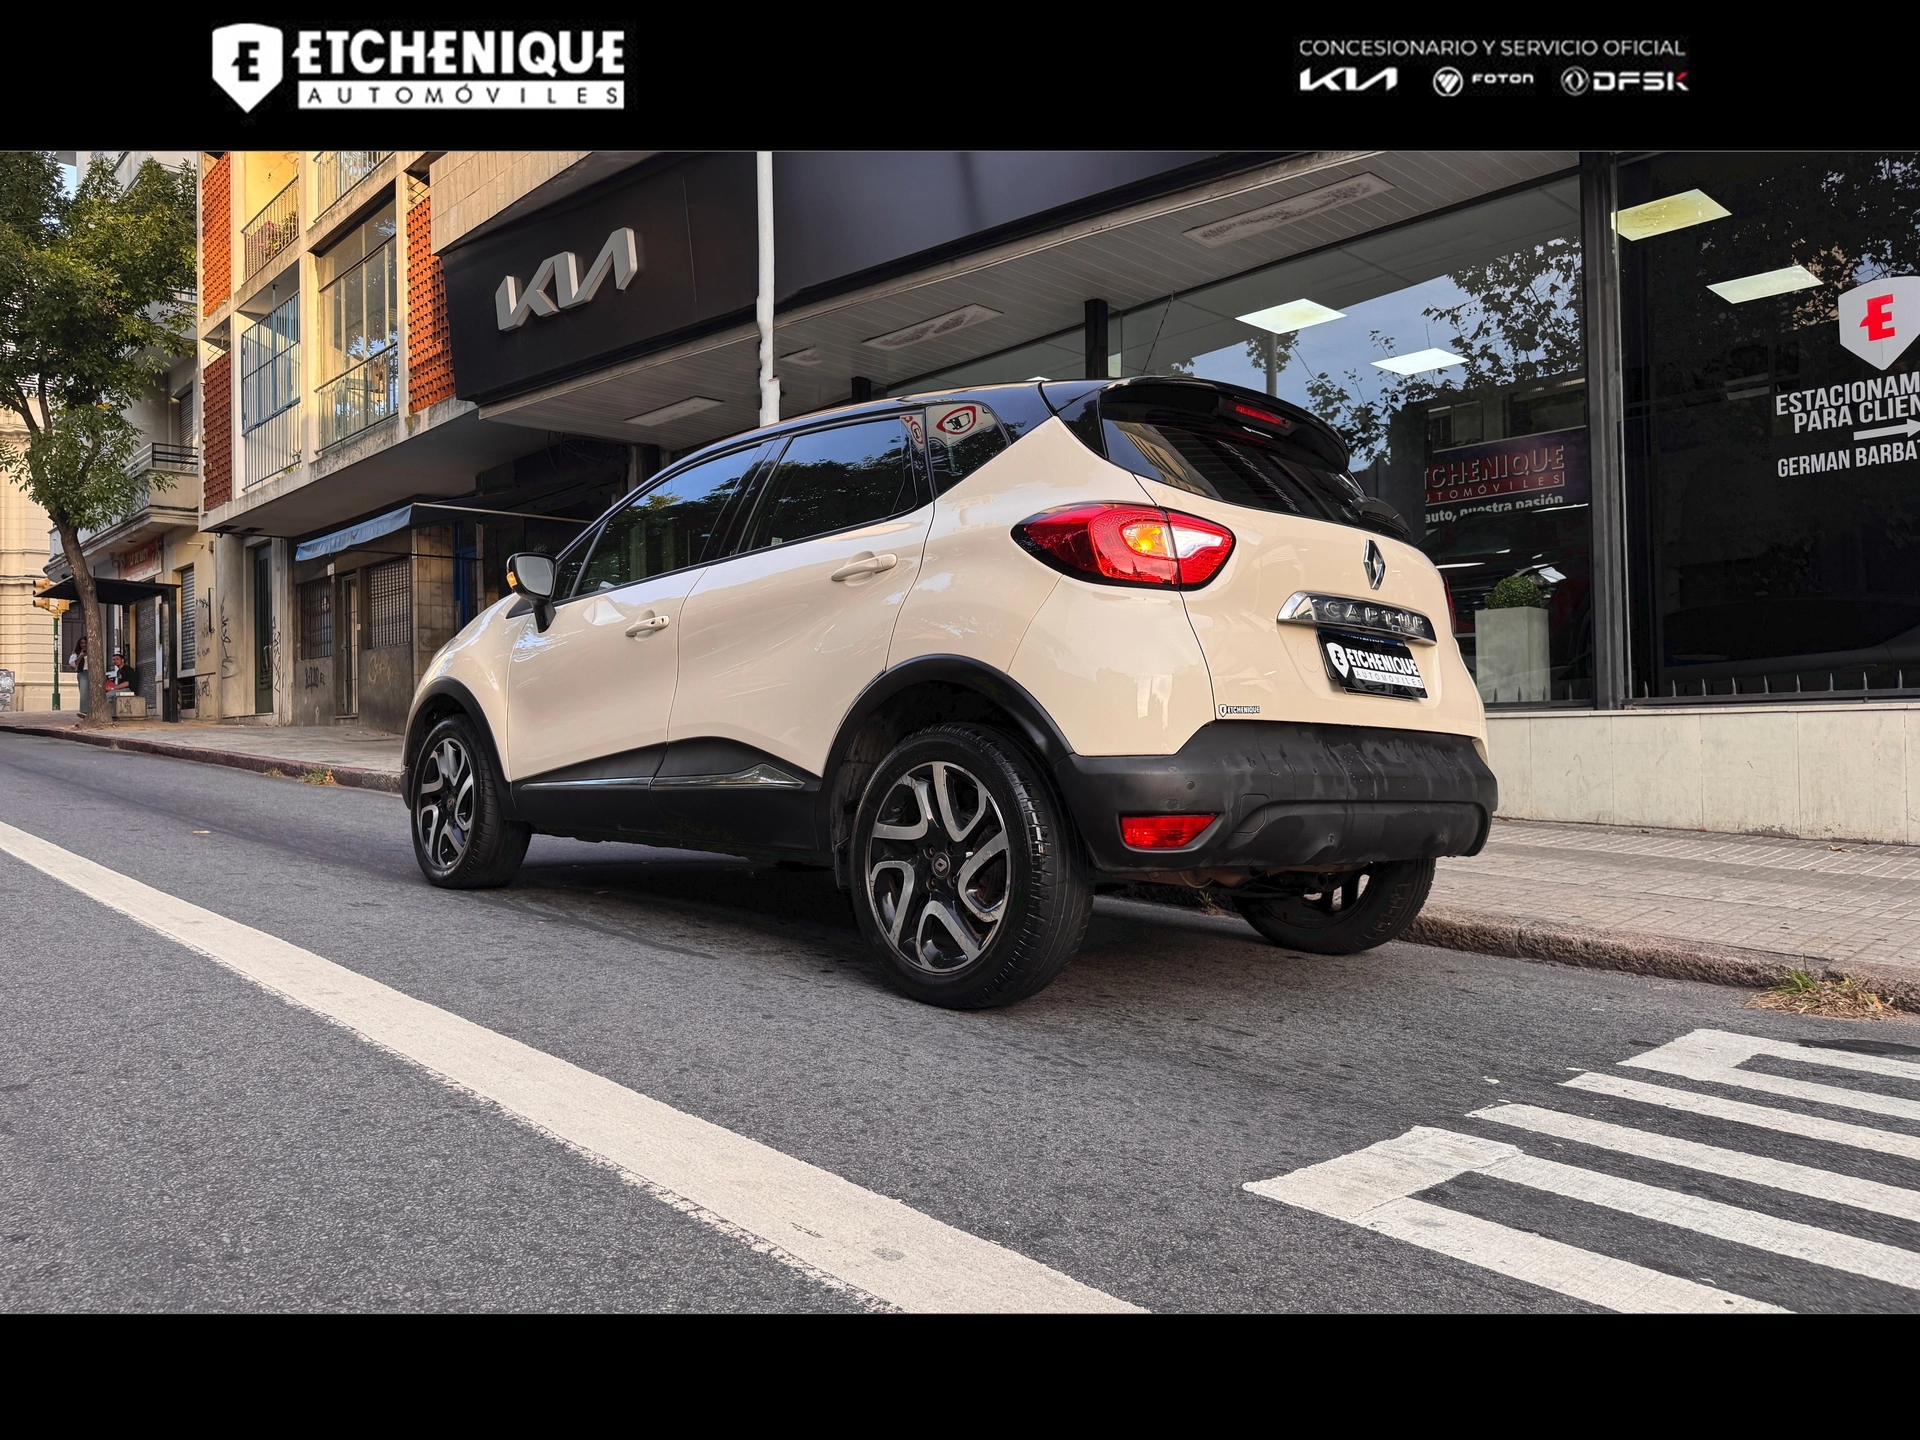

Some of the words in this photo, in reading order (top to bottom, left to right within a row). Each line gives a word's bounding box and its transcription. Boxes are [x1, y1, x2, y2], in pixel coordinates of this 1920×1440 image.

[495, 227, 638, 331] KIA
[1859, 293, 1896, 342] E
[1775, 370, 1920, 416] ESTACIONAM
[1794, 404, 1853, 434] PARA
[1777, 449, 1850, 478] GERMAN
[1324, 601, 1425, 631] CAPTUR
[1345, 647, 1420, 676] ETCHENIQUE
